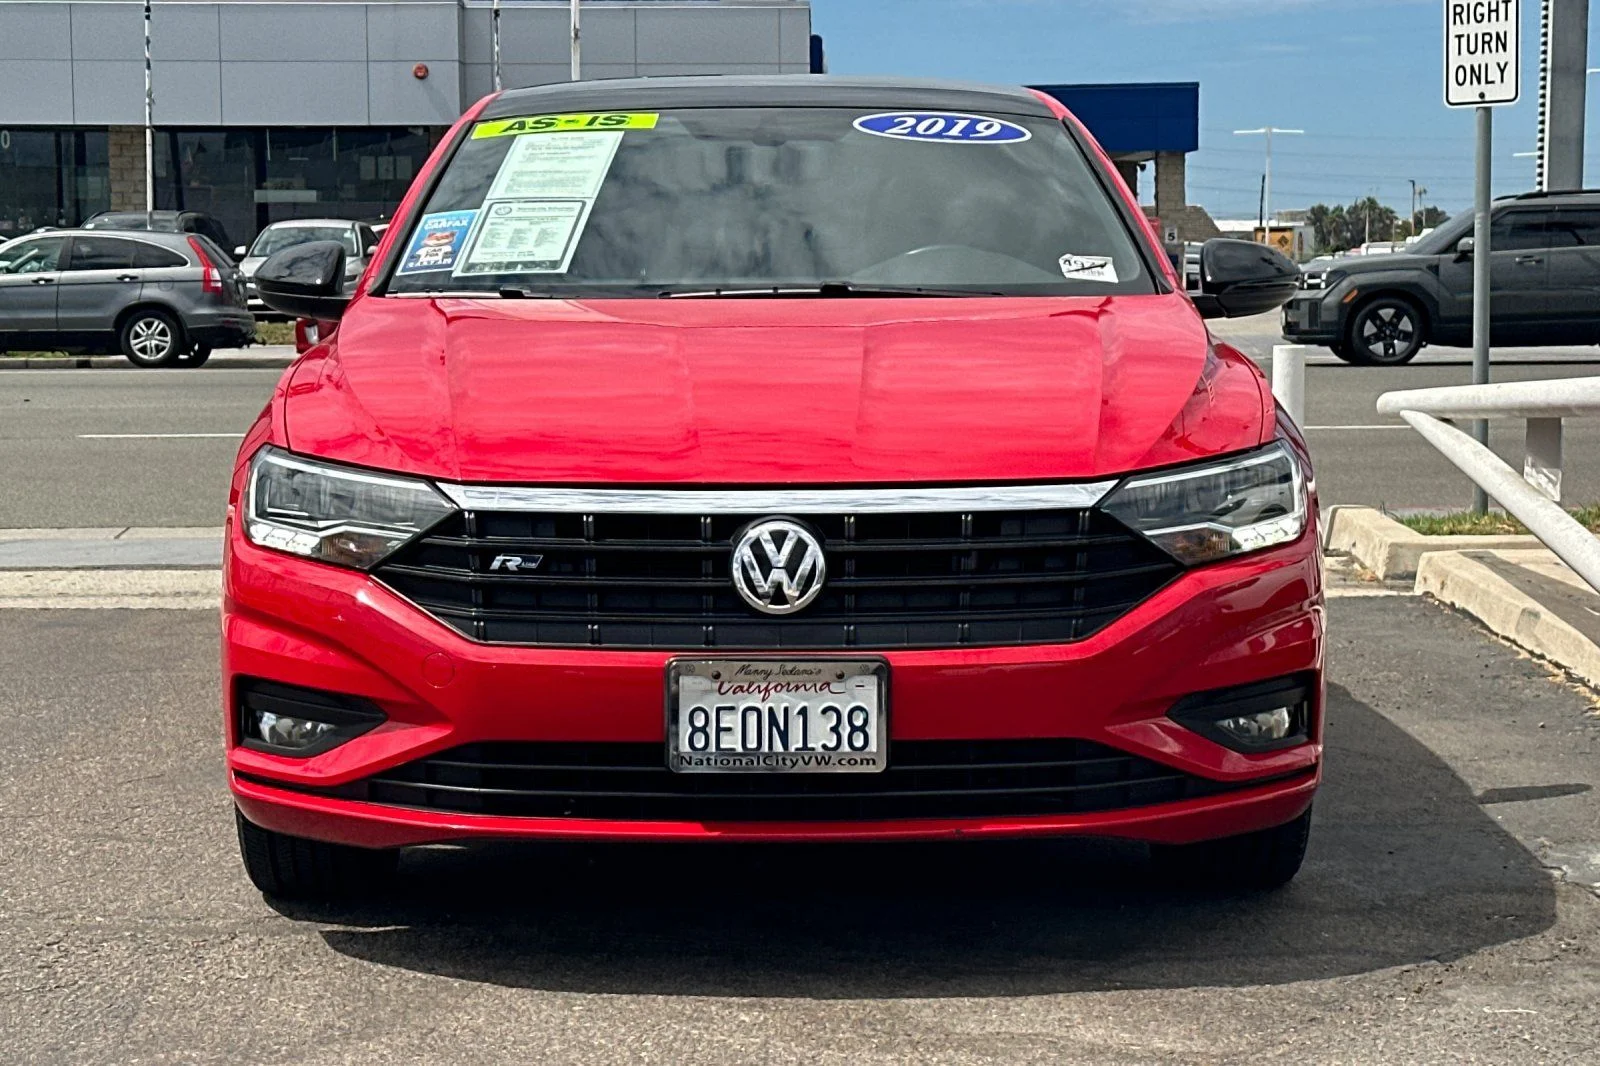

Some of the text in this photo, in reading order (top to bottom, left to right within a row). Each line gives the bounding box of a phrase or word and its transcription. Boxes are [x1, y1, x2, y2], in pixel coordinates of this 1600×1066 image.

[1453, 1, 1512, 26] RIGHT
[1455, 30, 1507, 56] TURN
[1455, 61, 1508, 87] ONLY
[884, 117, 1002, 138] 2019
[717, 680, 846, 702] California
[687, 705, 870, 752] 8EON138
[679, 755, 877, 768] NationalCityVW.com
